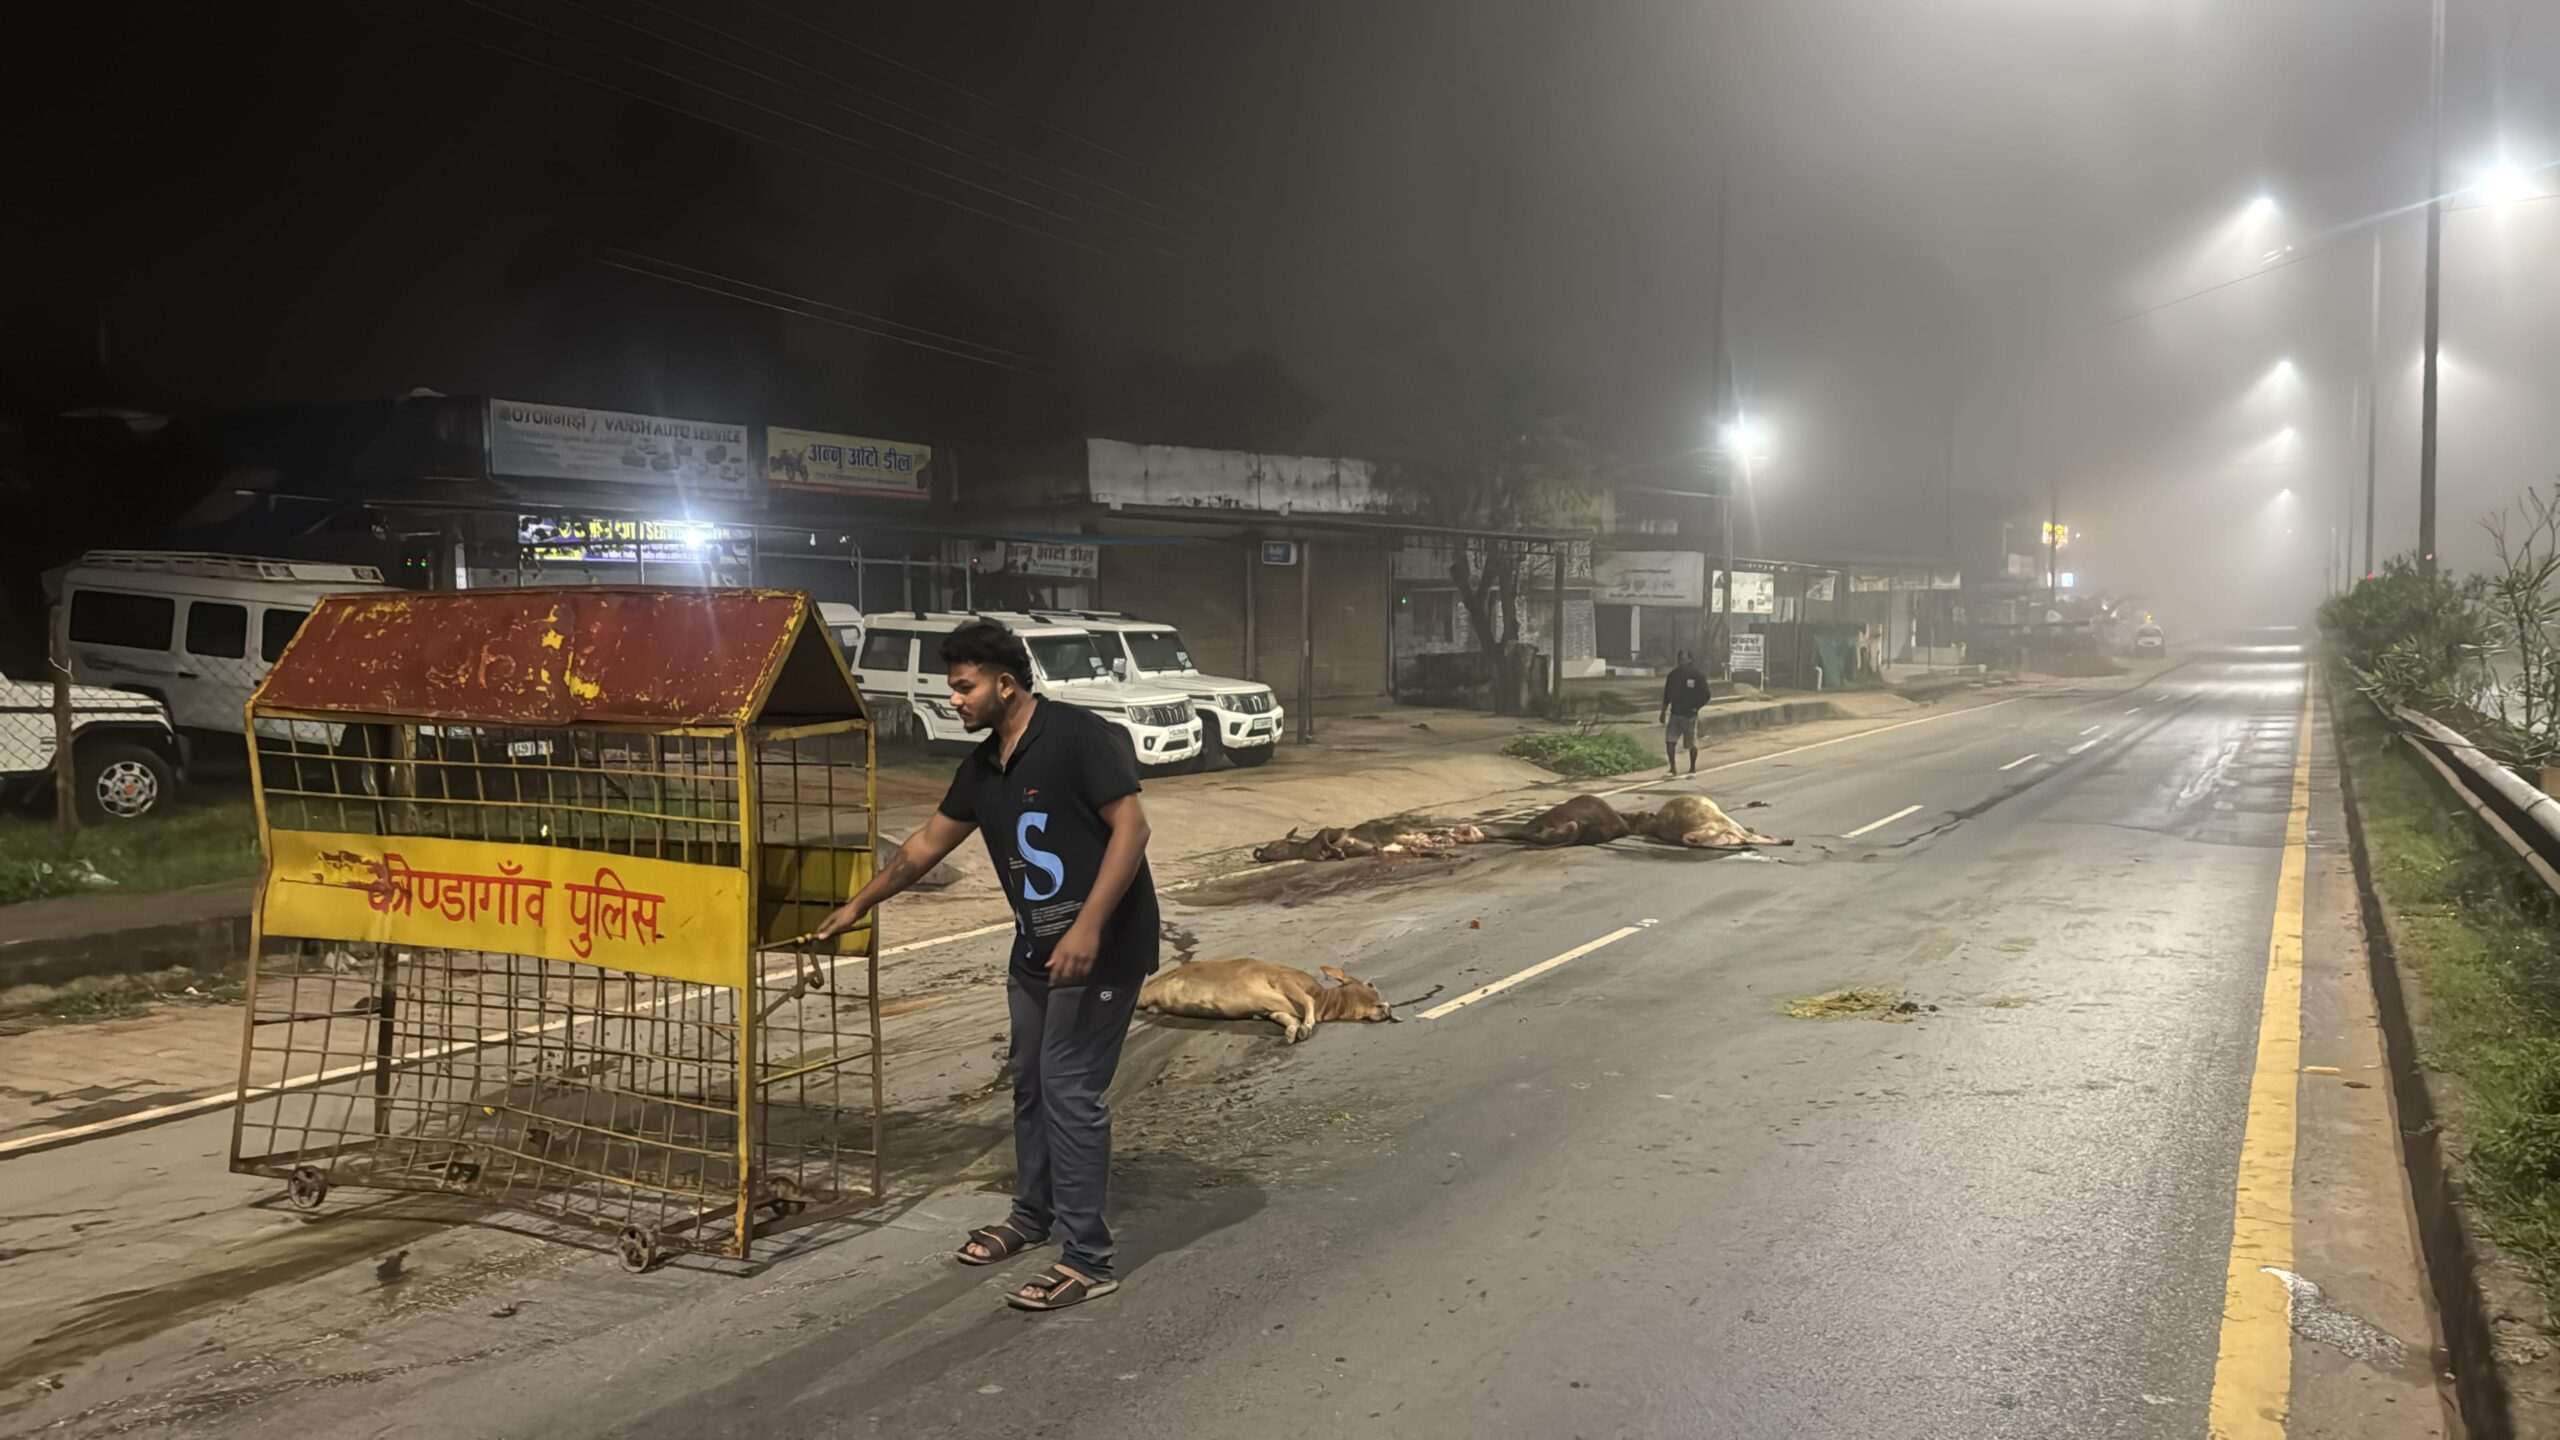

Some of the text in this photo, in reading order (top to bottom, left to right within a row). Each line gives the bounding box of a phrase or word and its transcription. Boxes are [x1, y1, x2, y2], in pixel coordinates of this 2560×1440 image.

[883, 447, 912, 471] डील
[1017, 811, 1064, 901] S
[564, 867, 665, 959] पुलिस
